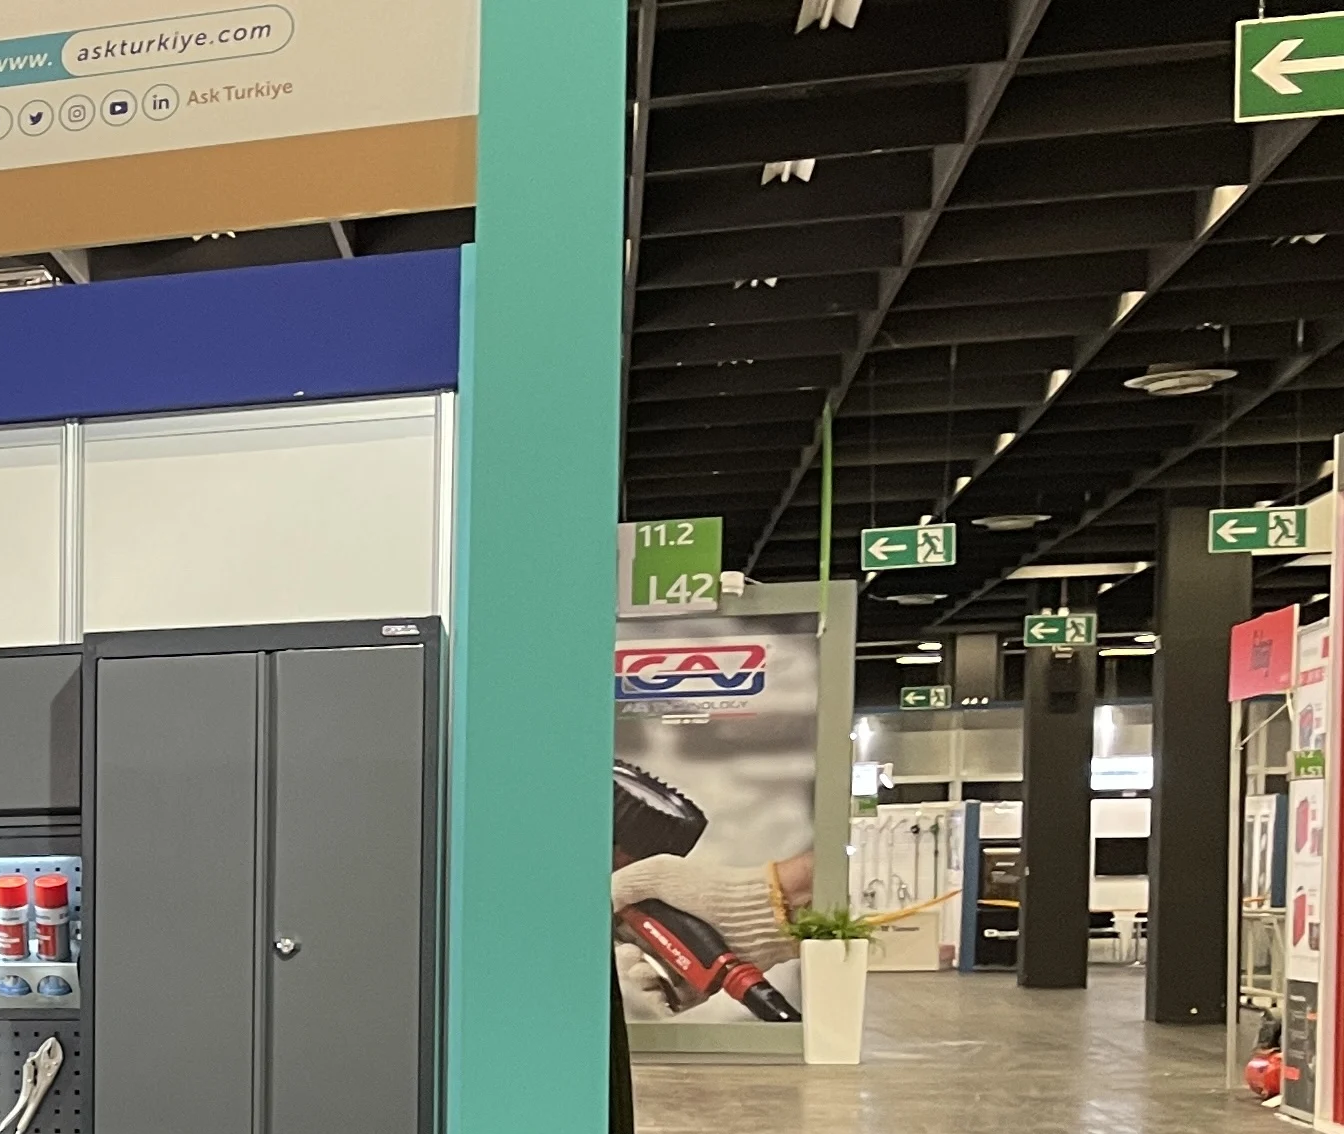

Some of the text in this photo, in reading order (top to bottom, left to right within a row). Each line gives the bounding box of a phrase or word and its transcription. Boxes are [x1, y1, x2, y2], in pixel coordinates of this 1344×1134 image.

[76, 22, 273, 62] askturkiye.com
[187, 80, 294, 106] Ask Turkiye
[638, 522, 694, 547] 11.2
[649, 573, 714, 605] L42
[624, 652, 758, 691] GAV
